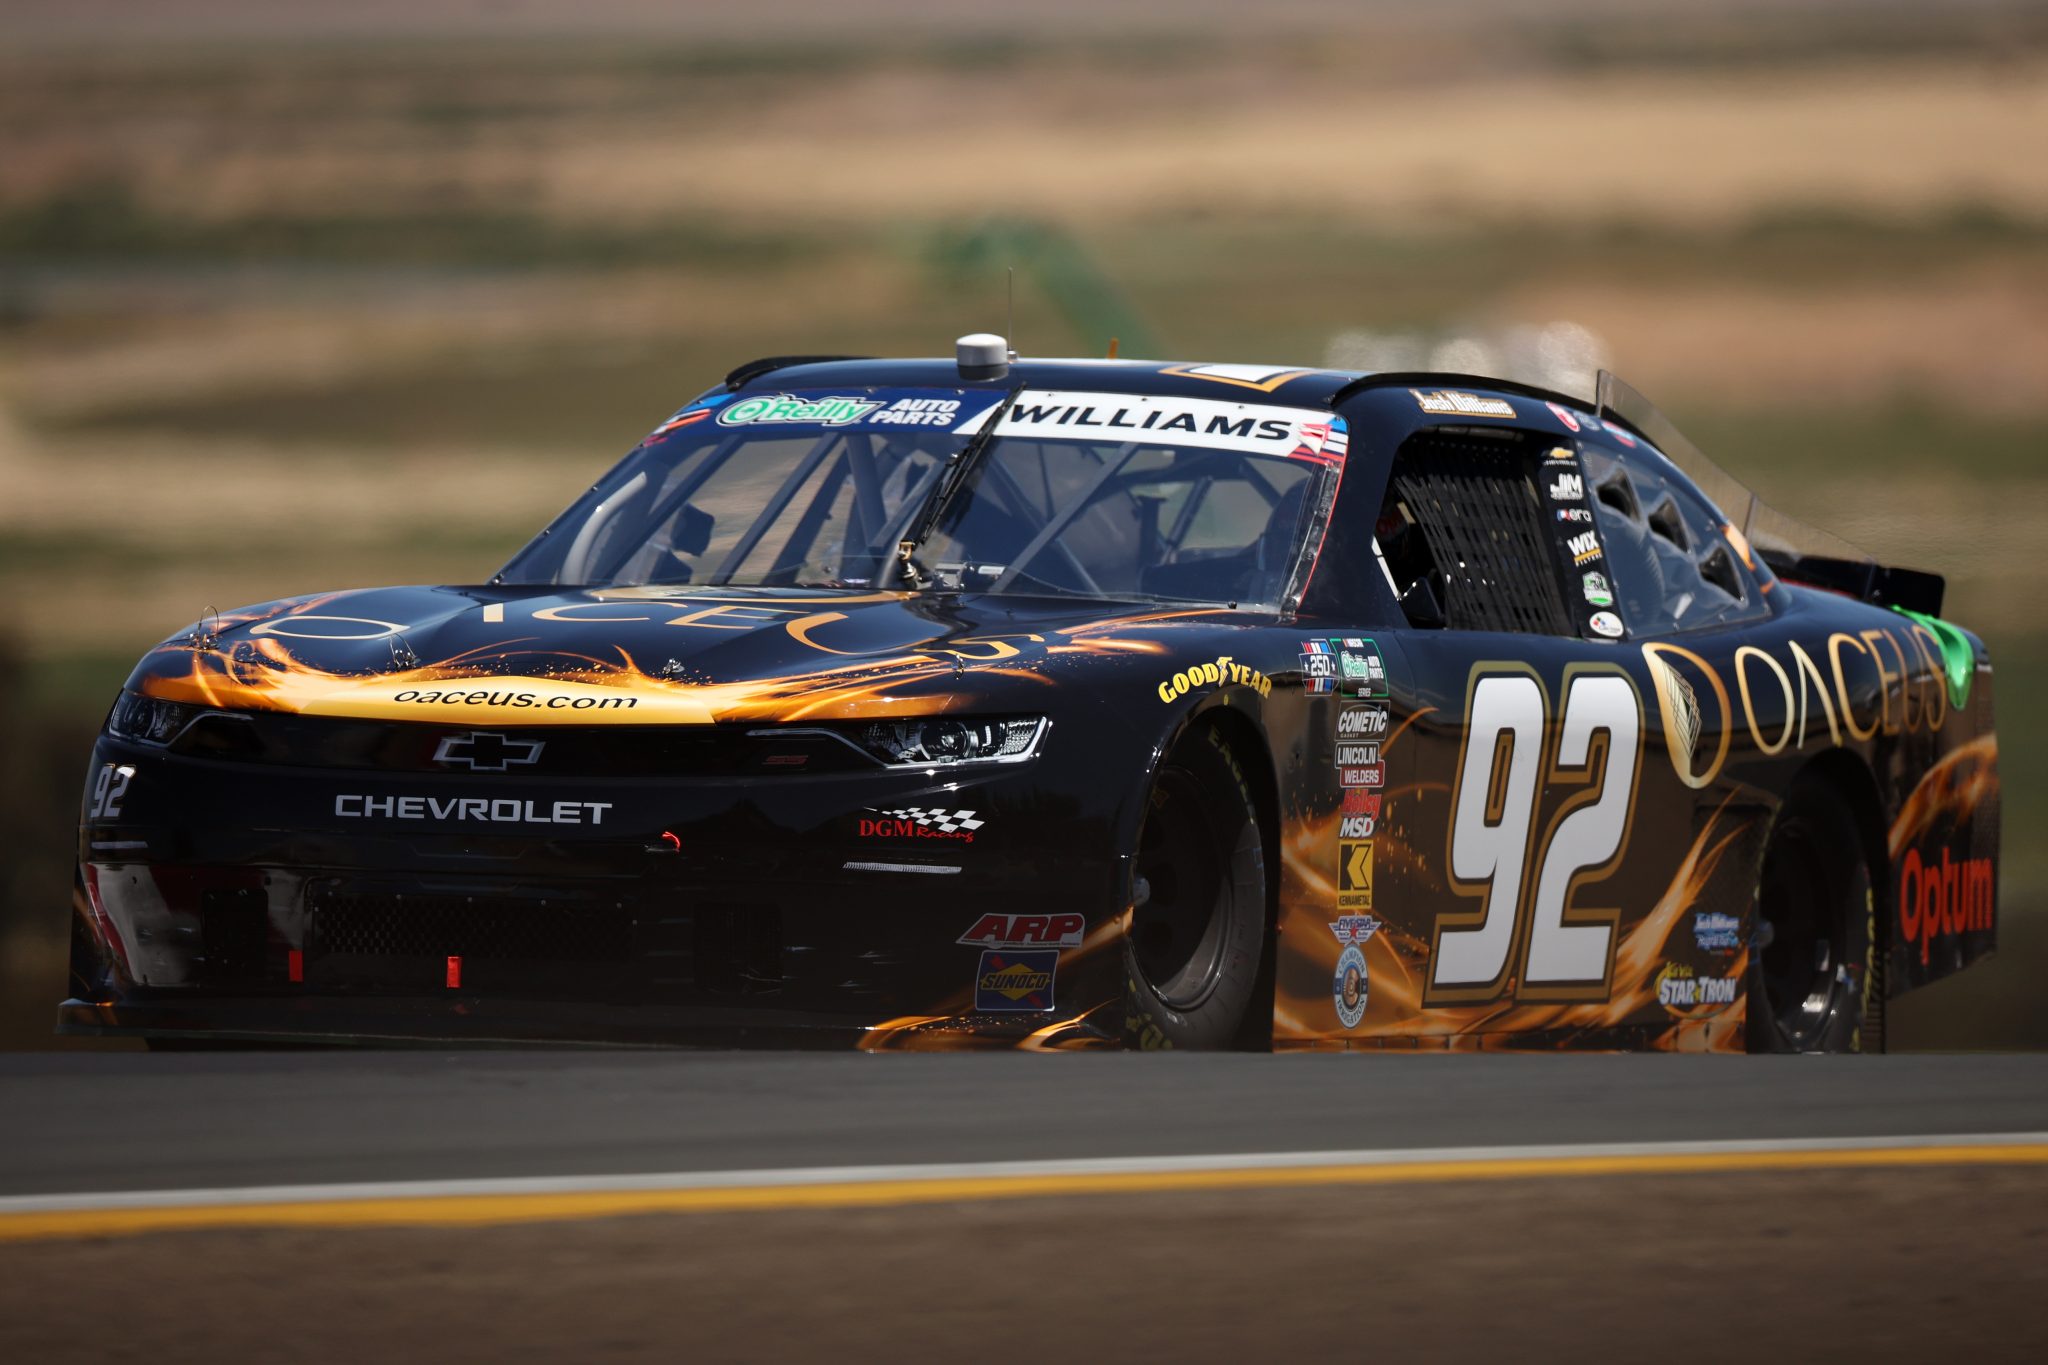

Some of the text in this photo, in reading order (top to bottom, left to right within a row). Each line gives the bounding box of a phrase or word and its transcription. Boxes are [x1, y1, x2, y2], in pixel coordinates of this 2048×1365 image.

[718, 395, 885, 425] O'Reilly
[888, 398, 961, 412] AUTO
[869, 410, 956, 426] PARTS
[1010, 403, 1293, 441] WILLIAMS
[1567, 530, 1600, 556] WIX
[1310, 655, 1330, 677] 250
[1158, 658, 1272, 703] GOODYEAR
[392, 687, 638, 710] oaceus.com
[1338, 711, 1388, 732] COMETIC
[1337, 747, 1377, 765] LINCOLN
[1344, 769, 1380, 784] WELDERS
[90, 764, 136, 818] 92
[334, 795, 613, 825] CHEVROLET
[858, 819, 975, 843] DGM Racing
[1340, 818, 1374, 838] MSD
[1430, 670, 1642, 992] 92
[1901, 846, 1993, 965] Optum
[961, 915, 1084, 942] ARP
[982, 973, 1048, 989] SUNOCO
[1660, 976, 1736, 1005] STAR TRON
